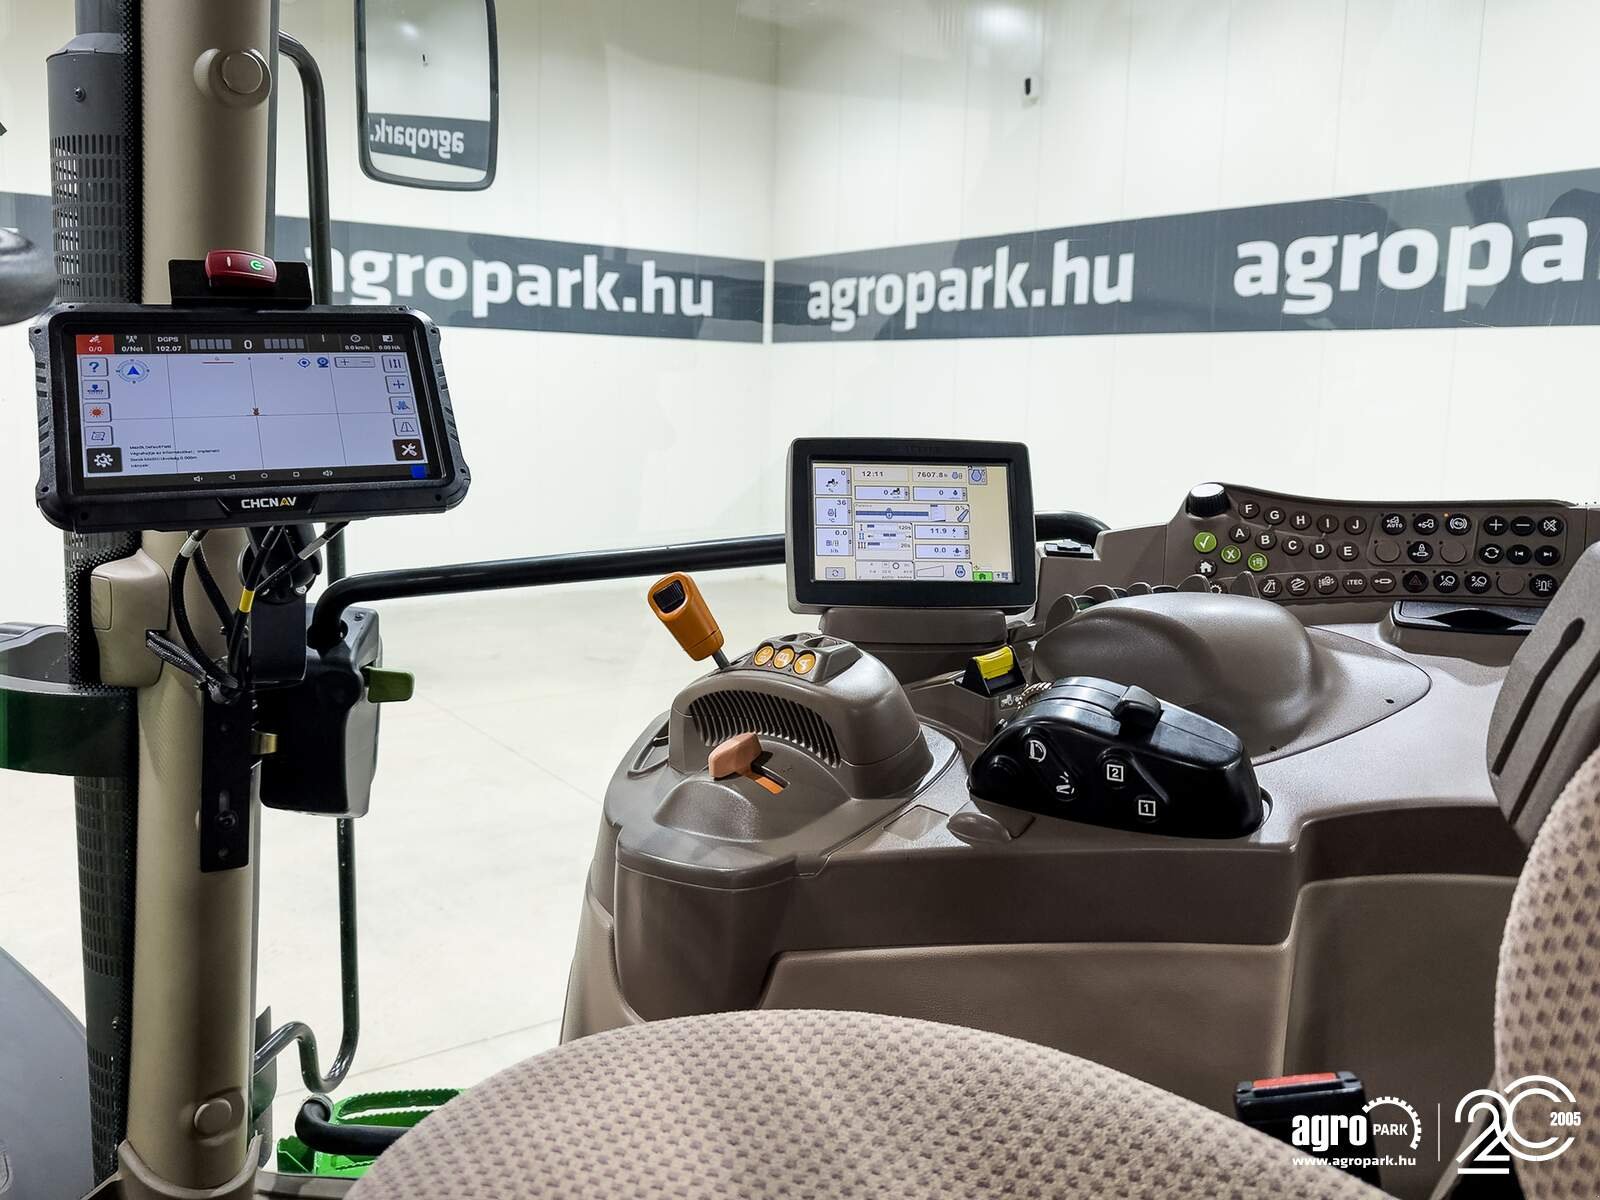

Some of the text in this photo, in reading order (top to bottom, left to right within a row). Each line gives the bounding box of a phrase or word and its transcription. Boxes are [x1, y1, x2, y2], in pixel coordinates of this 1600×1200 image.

[1233, 214, 1600, 317] agropa
[807, 239, 1135, 333] agropark.hu
[241, 496, 297, 509] CHCNAV
[1245, 505, 1252, 513] F
[1270, 510, 1280, 520] G
[1296, 516, 1305, 525] H
[1352, 519, 1359, 529] J
[1235, 528, 1245, 537] A
[1261, 535, 1270, 545] B
[1288, 540, 1297, 550] C
[1315, 544, 1324, 554] D
[1343, 546, 1352, 556] E
